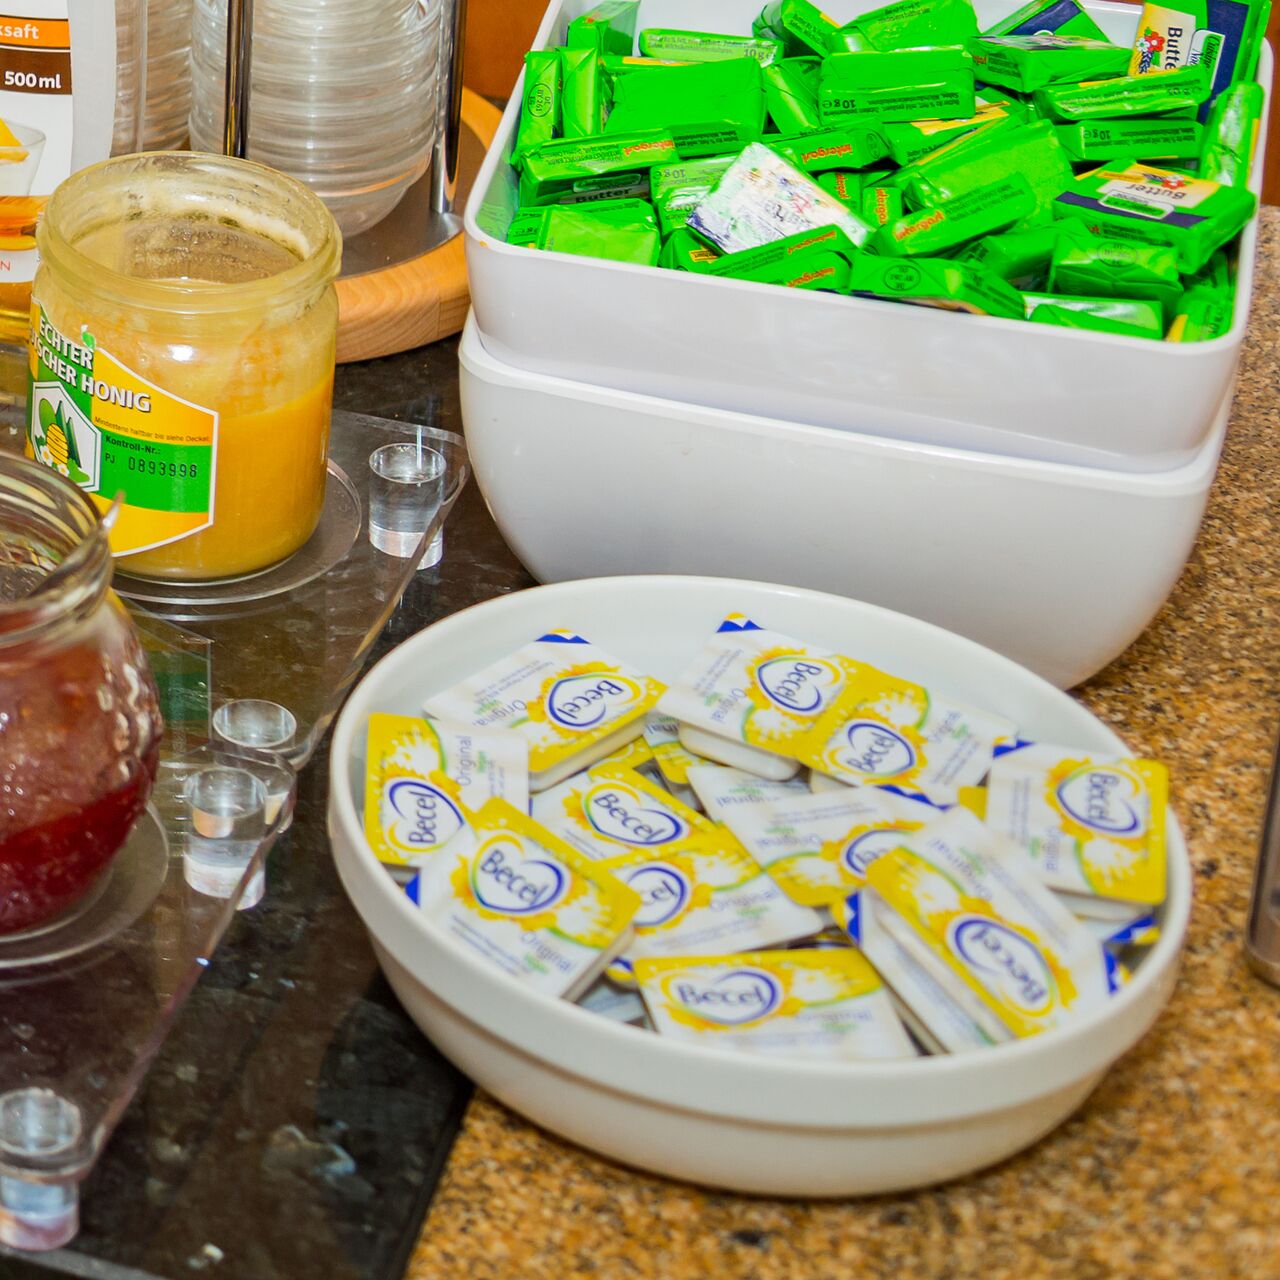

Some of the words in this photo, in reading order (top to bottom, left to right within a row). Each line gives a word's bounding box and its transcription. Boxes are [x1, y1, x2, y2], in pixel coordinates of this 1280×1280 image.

[1166, 26, 1183, 71] Butte
[4, 71, 37, 88] 500
[39, 73, 61, 89] ml
[574, 187, 632, 202] Butter
[1125, 183, 1187, 199] Butter
[39, 316, 93, 371] ECHTER
[82, 374, 151, 413] HONIG
[556, 679, 624, 720] Becel
[773, 661, 822, 706] Becel
[455, 735, 473, 787] Original
[408, 791, 438, 846] Becel
[593, 793, 666, 841] Becel
[480, 849, 549, 907] Becel
[969, 926, 1045, 1004] Becel
[677, 983, 767, 1007] Becel
